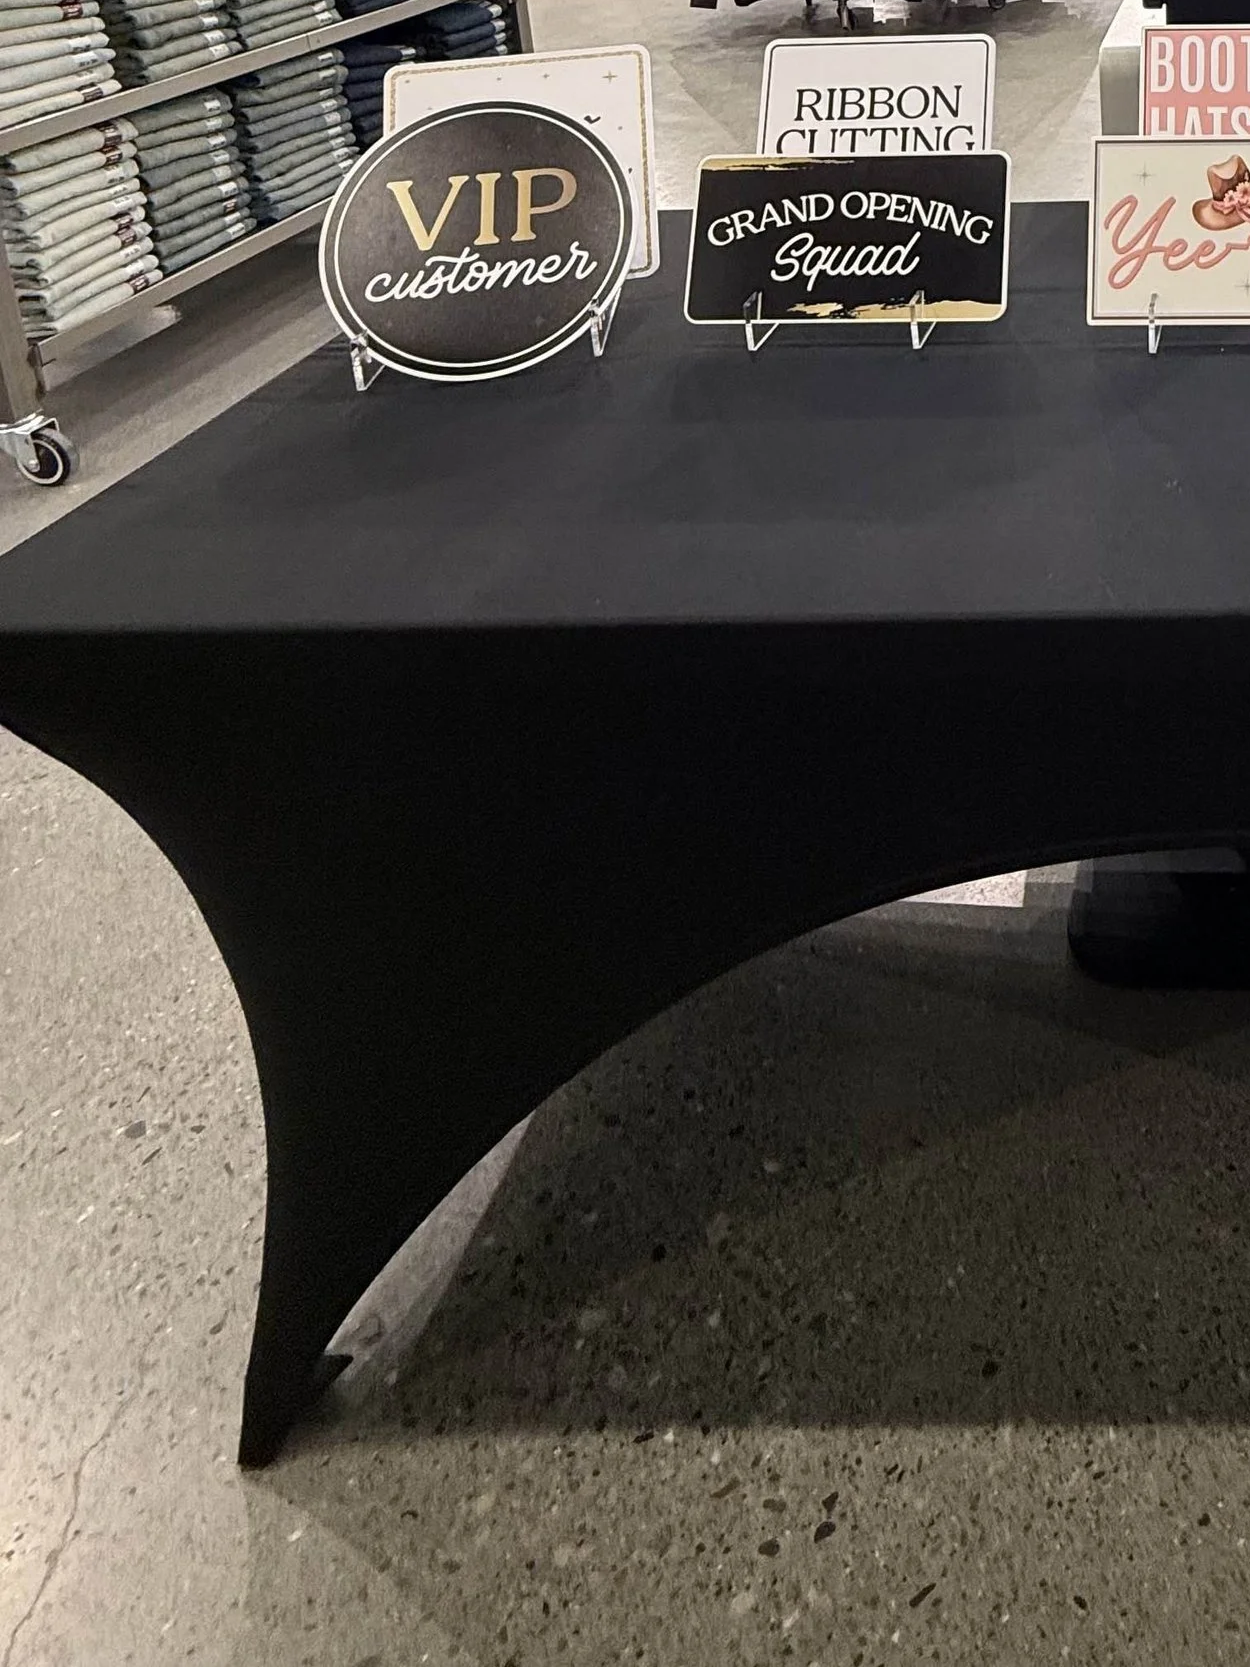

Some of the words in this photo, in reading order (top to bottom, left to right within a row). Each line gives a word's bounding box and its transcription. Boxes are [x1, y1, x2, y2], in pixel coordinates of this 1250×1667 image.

[793, 84, 963, 122] RIBBON
[775, 125, 976, 154] CUTTING
[386, 167, 578, 252] VIP
[706, 193, 835, 246] GRAND
[840, 190, 994, 245] OPENING
[363, 240, 598, 304] customer
[770, 231, 922, 292] Squad
